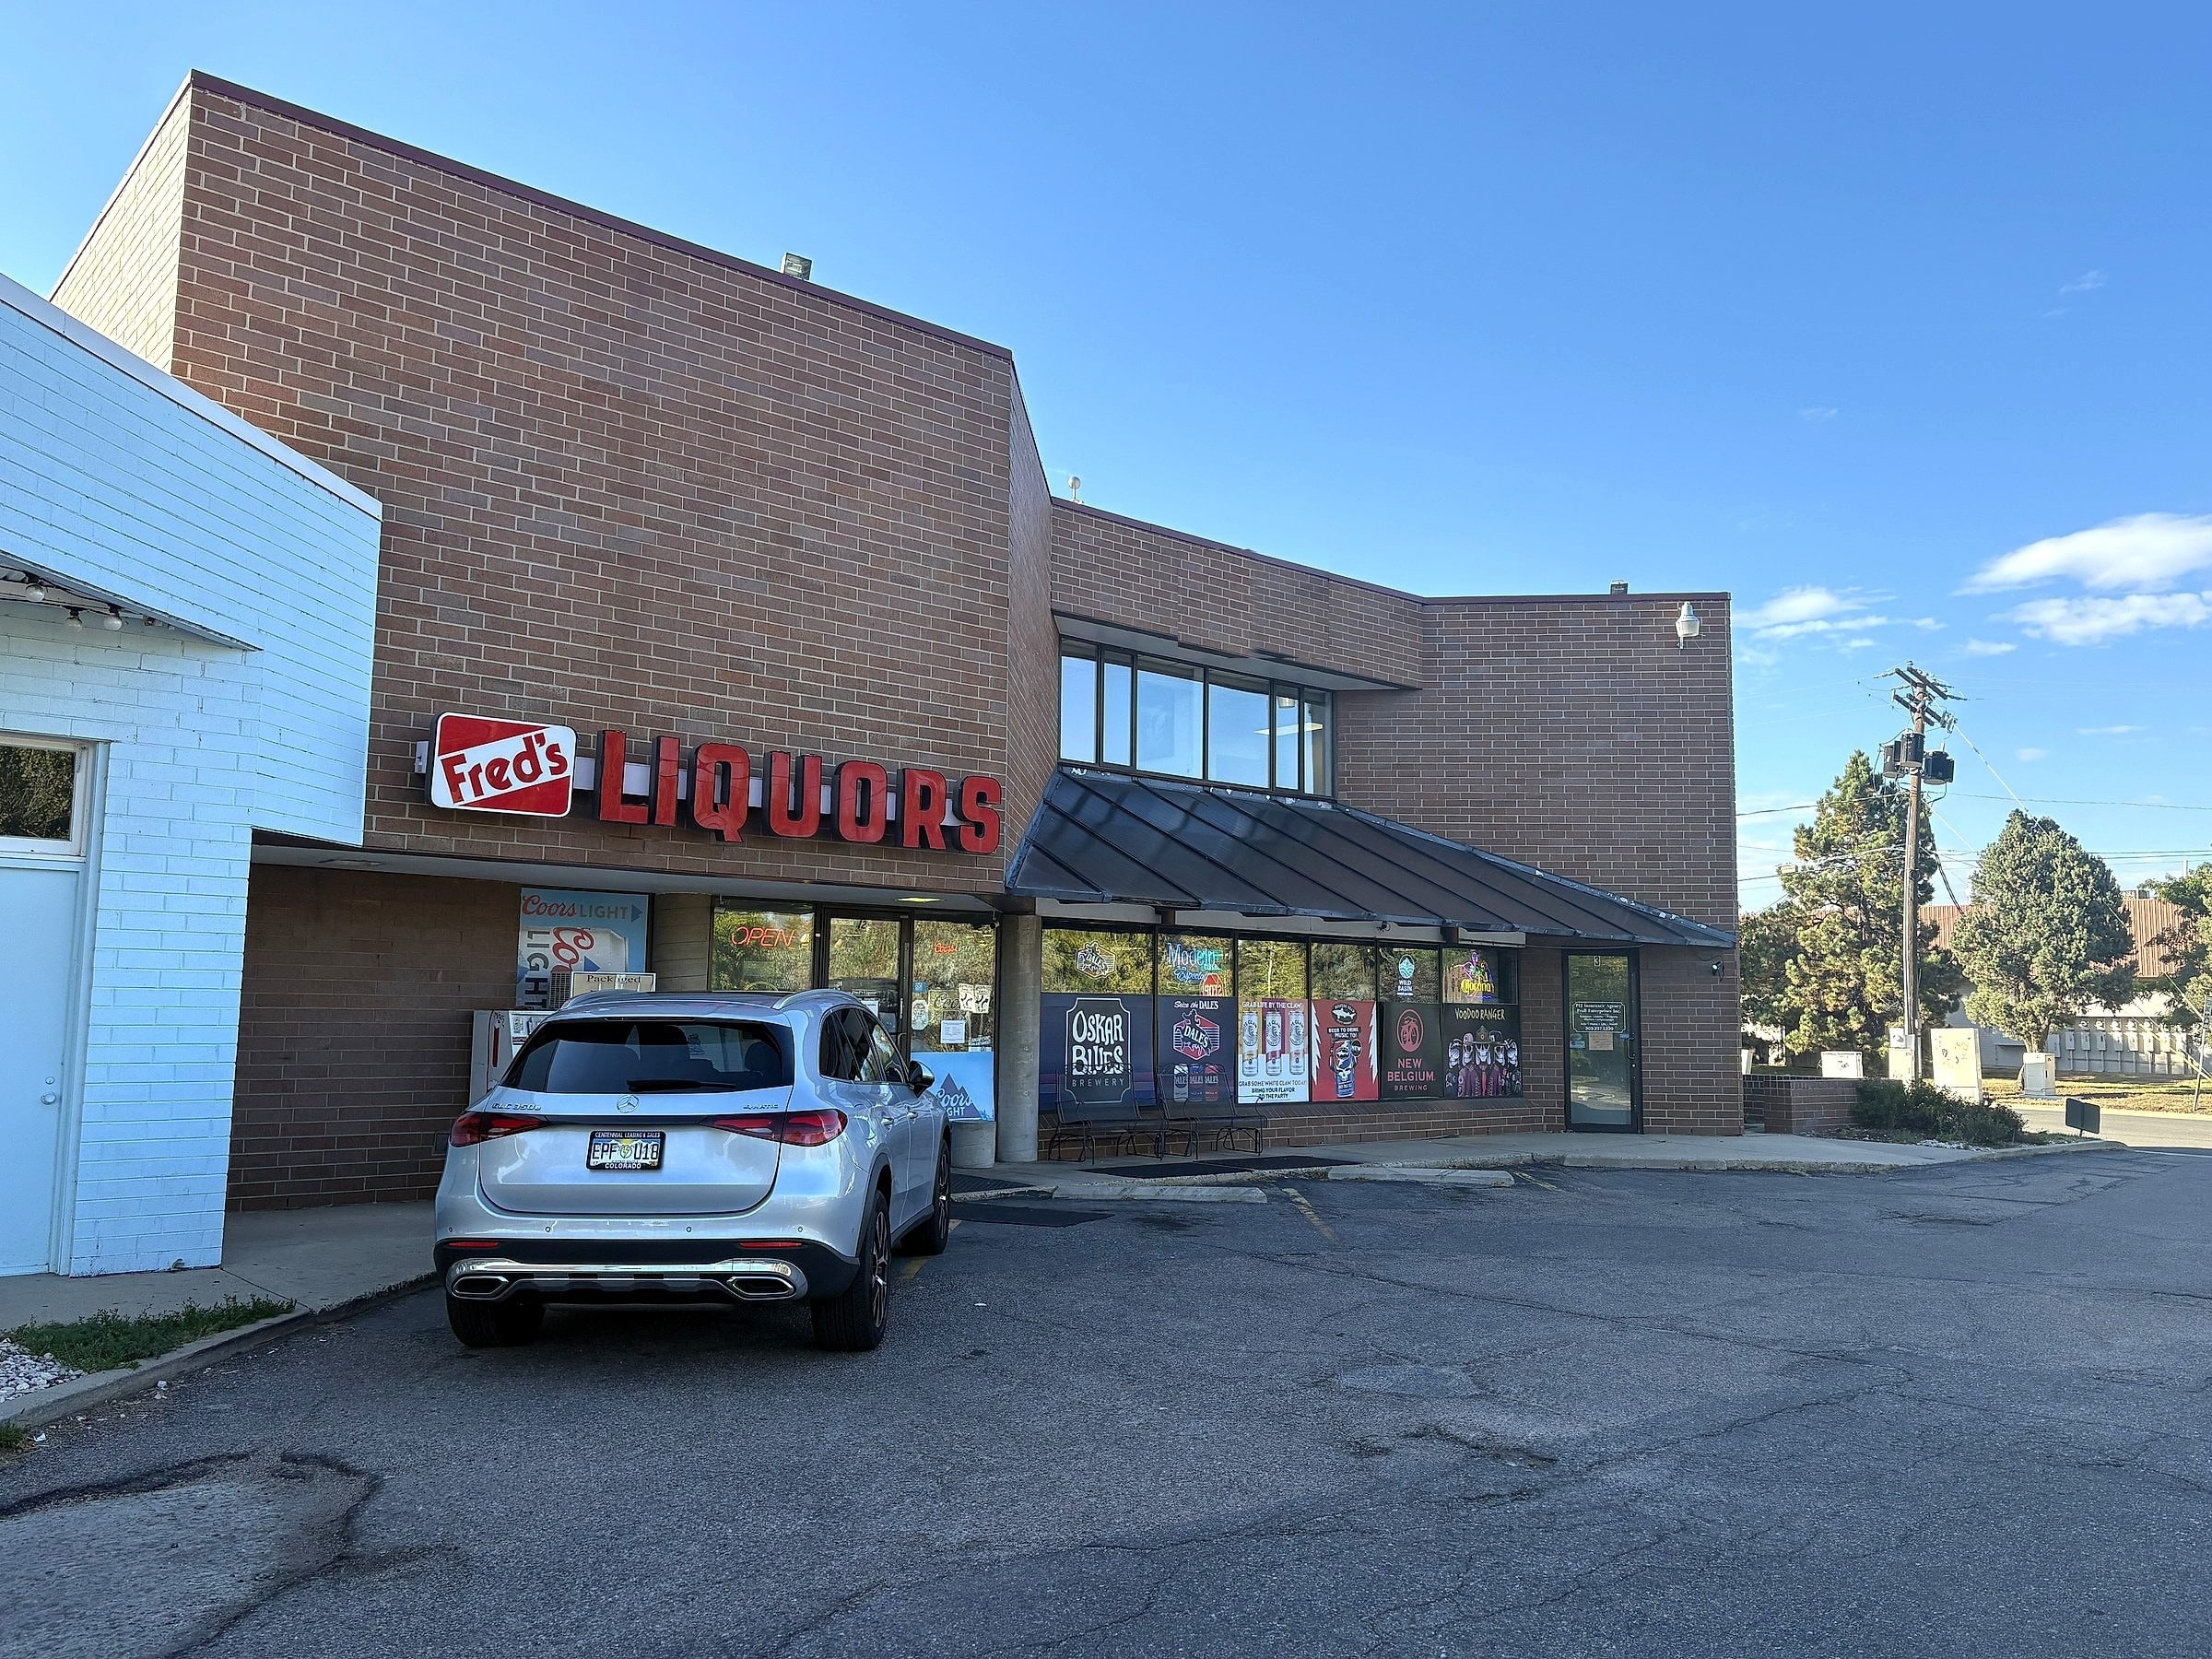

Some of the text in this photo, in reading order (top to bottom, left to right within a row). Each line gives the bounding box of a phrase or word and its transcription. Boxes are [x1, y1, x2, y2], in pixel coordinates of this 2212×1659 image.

[441, 732, 568, 804] Fred's
[594, 730, 1001, 853] LIQUORS
[522, 894, 629, 920] Coors LIGHT
[731, 926, 795, 947] OPEN
[1594, 956, 1601, 967] 3
[1198, 1000, 1219, 1010] DALES
[1454, 1007, 1506, 1020] VOODOO RANGER
[1072, 1010, 1124, 1045] OSKAR
[1183, 1025, 1209, 1048] DALES
[1072, 1045, 1124, 1076] BLUES
[1397, 1058, 1422, 1069] NEW
[1072, 1078, 1124, 1088] BREWERY
[1387, 1071, 1434, 1082] BELGIUM
[944, 1106, 966, 1116] GHT
[592, 1142, 660, 1160] EPF U18
